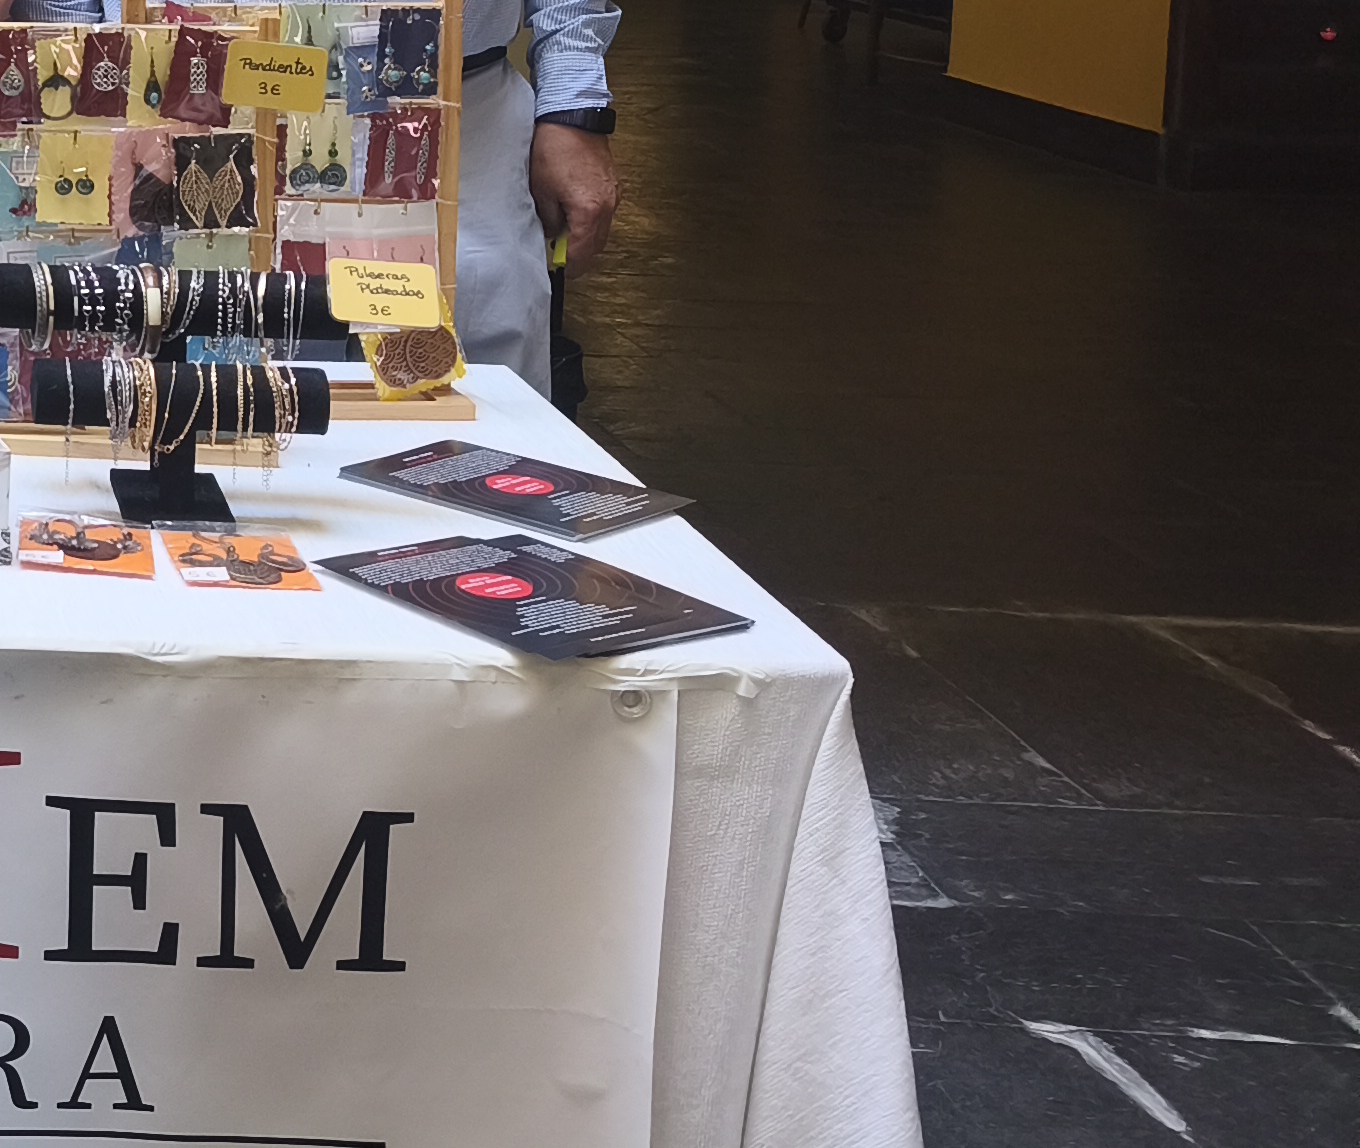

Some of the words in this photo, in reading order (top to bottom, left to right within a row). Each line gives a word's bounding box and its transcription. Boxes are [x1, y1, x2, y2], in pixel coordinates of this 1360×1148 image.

[239, 56, 315, 77] Pendientes
[258, 81, 281, 96] 3€
[369, 304, 391, 316] 3€
